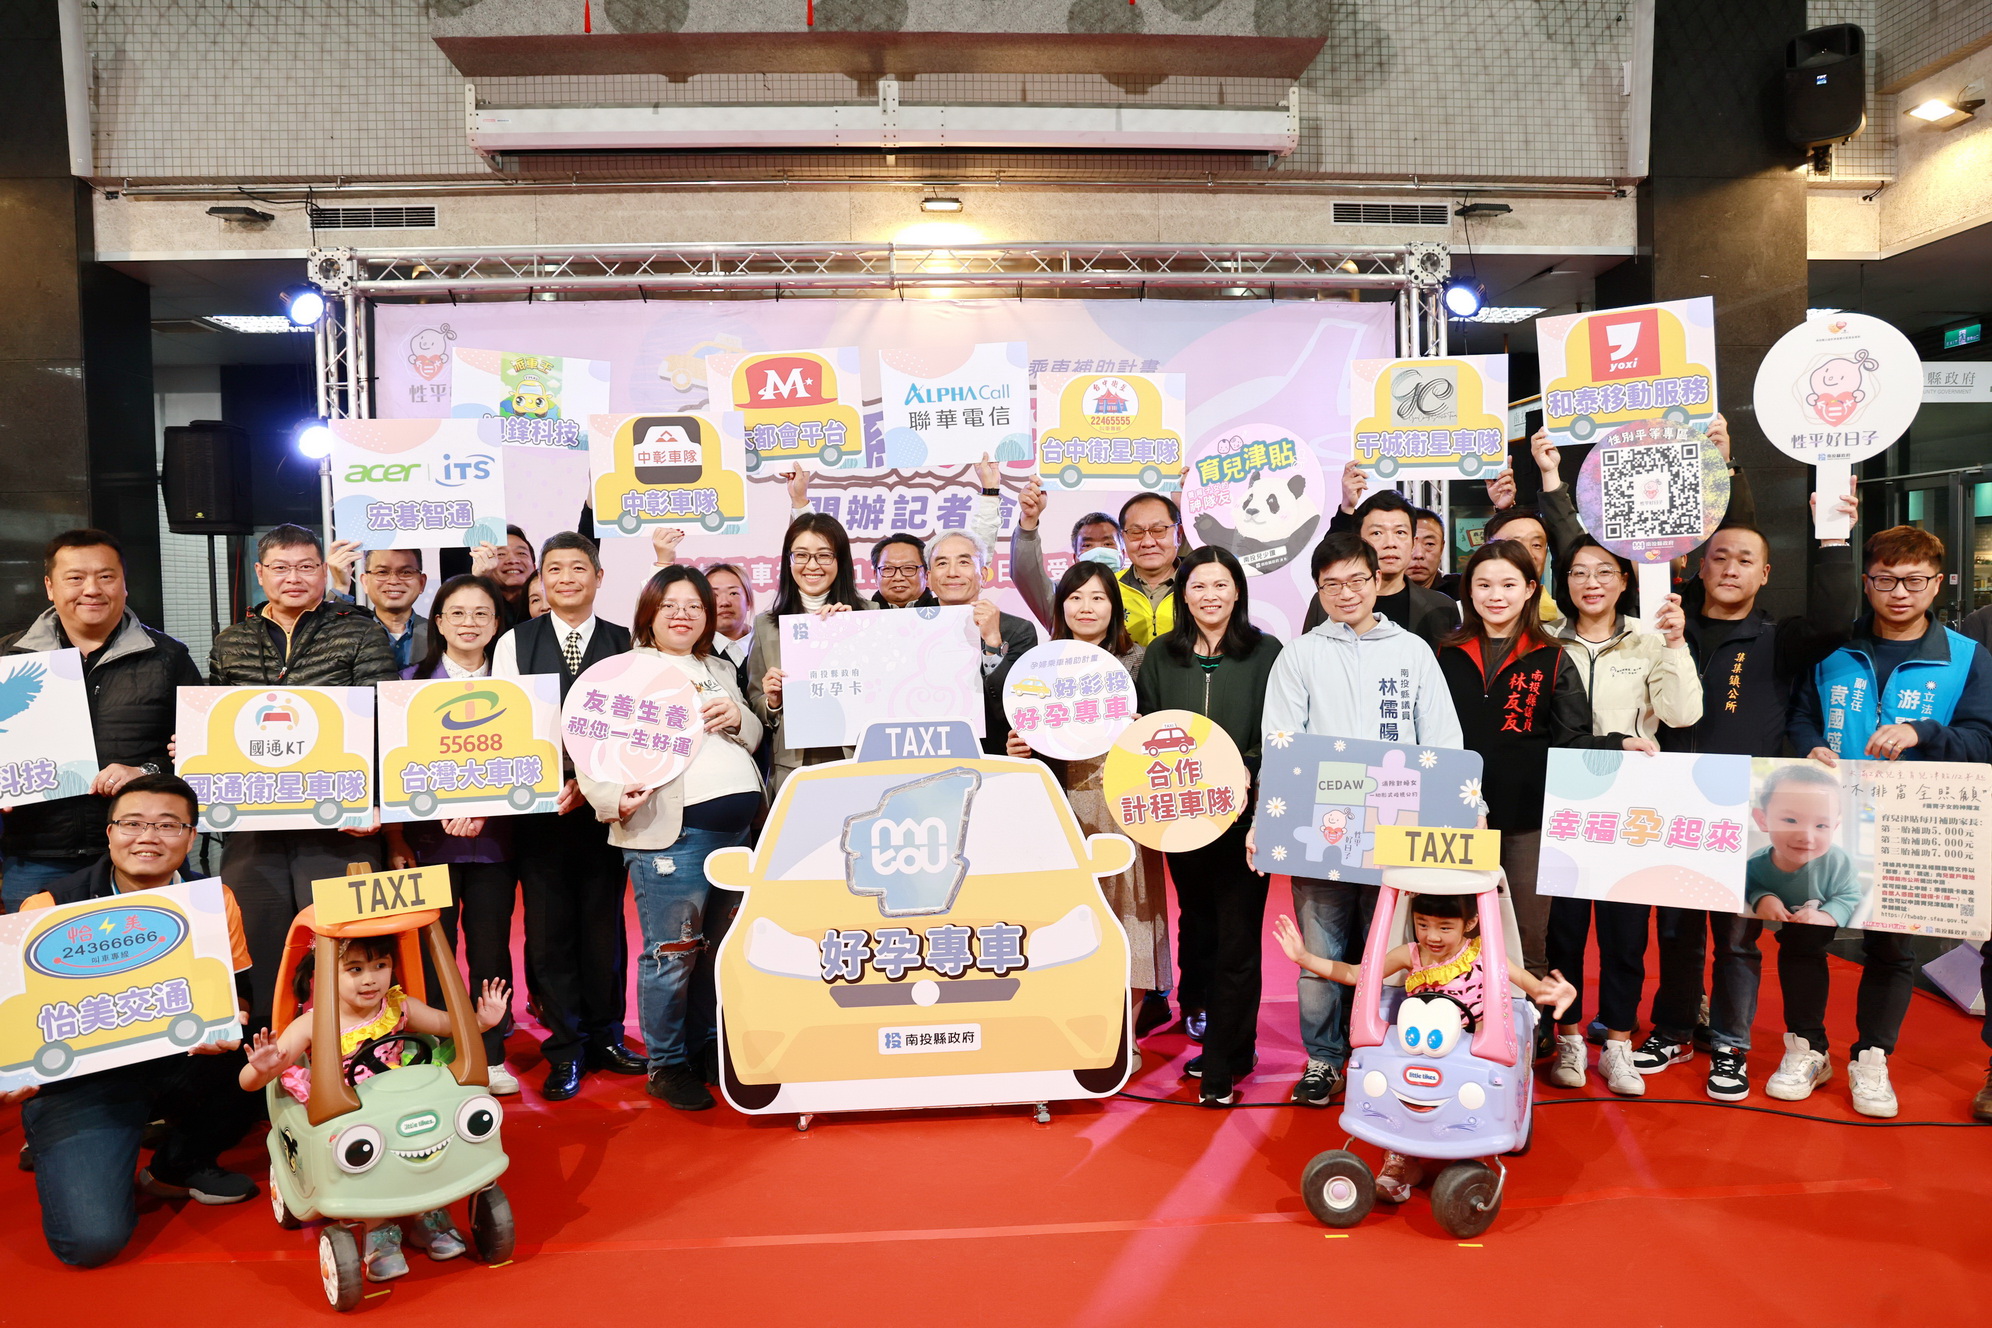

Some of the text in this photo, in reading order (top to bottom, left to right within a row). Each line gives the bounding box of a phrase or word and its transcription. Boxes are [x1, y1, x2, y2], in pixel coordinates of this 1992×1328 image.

[1609, 358, 1638, 372] yoxi
[1927, 371, 1976, 385] 縣政府
[409, 384, 451, 403] 性平
[904, 382, 1010, 406] ALPHA Call
[1548, 376, 1709, 418] 和泰移動服務
[501, 417, 580, 446] 鋒科技
[909, 405, 1010, 432] 聯華電信
[1091, 416, 1131, 425] 22465555
[1041, 437, 1180, 465] 台中衛星車隊
[1355, 428, 1503, 460] 干城衛星車隊
[1608, 428, 1689, 446] 性別平等專區
[1791, 430, 1879, 449] 性平好日子
[638, 449, 698, 465] 中彰車隊
[1197, 440, 1296, 486] 育兒津貼
[344, 463, 421, 483] acer
[367, 500, 474, 531] 宏碁智通
[622, 487, 720, 518] 中彰車隊
[810, 669, 860, 679] 南投縣政府
[811, 681, 862, 698] 好孕卡
[1054, 671, 1128, 698] 好彩投
[1724, 652, 1746, 714] 集集鎮公所
[583, 689, 689, 731] 友善生養
[1400, 668, 1411, 721] 南投縣議員
[1500, 672, 1528, 733] 林友友
[1850, 677, 1868, 713] 副主任
[1012, 695, 1135, 732] 好孕專車
[1826, 684, 1850, 754] 袁國盛
[250, 740, 305, 756] 國通KT
[440, 733, 503, 754] 55688
[567, 716, 693, 757] 祝您一生好運
[885, 726, 951, 757] TAXI
[183, 772, 367, 805] 國通衛星車隊
[401, 757, 543, 793] 台灣大車隊
[1146, 758, 1201, 789] 合作
[1318, 779, 1364, 791] CEDAW
[1121, 786, 1235, 824] 計程車隊
[1548, 808, 1743, 852] 幸福孕起來
[1405, 831, 1474, 865] TAXI
[348, 873, 425, 914] TAXI
[67, 914, 147, 944] 怡 美
[62, 931, 158, 959] 24366666
[820, 922, 1028, 984] 好孕專車
[38, 978, 193, 1043] 怡美交通
[905, 1031, 975, 1046] 南投縣政府
